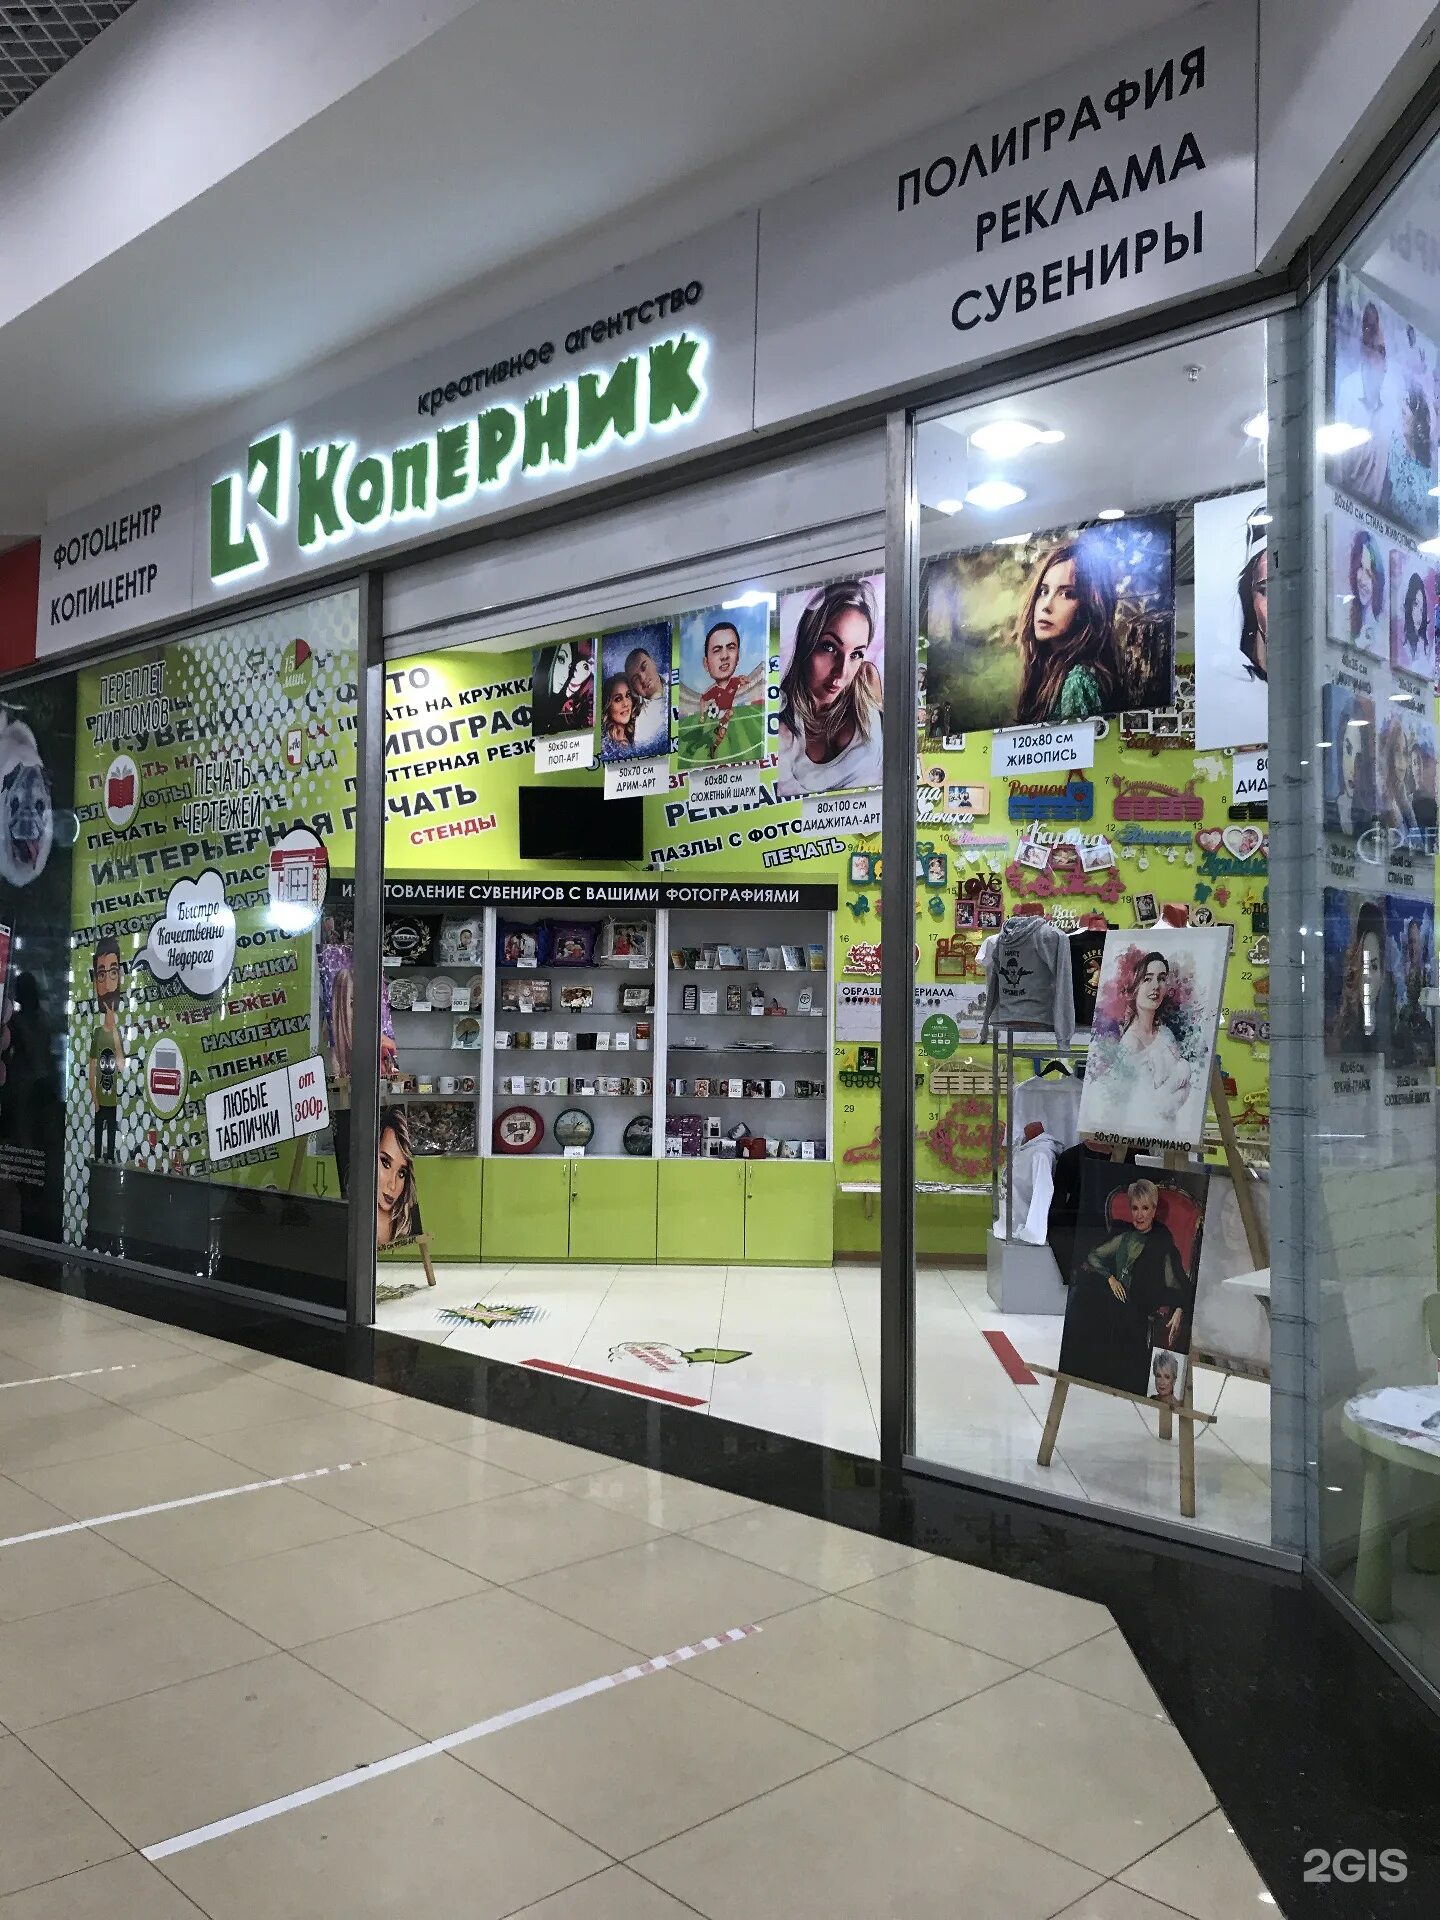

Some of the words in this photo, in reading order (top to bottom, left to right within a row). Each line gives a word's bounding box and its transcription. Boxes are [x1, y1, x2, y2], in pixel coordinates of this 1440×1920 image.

[897, 46, 1206, 212] ПОЛИГРАФИЯ
[976, 132, 1206, 252] РЕКЛАМА
[951, 210, 1204, 331] СУВЕНИРЫ
[417, 338, 555, 416] креативное
[564, 280, 704, 356] агентство
[53, 503, 162, 569] ФОТОЦЕНТР
[50, 563, 158, 626] КОПИЦЕНТР
[100, 660, 166, 707] ПЕРЕПЛЕТ
[425, 696, 453, 713] НА
[94, 696, 170, 748] ДИПЛОМОВ
[487, 738, 535, 762] РЕЗК
[569, 740, 580, 749] см
[1013, 733, 1052, 749] 120х80
[1056, 733, 1073, 744] см
[548, 753, 580, 766] ПОП-АРТ
[1006, 748, 1077, 767] ЖИВОПИСЬ
[194, 758, 251, 797] ПЕЧАТЬ
[619, 765, 641, 778] 50х70
[642, 767, 654, 776] см
[704, 773, 729, 787] 60х80
[730, 774, 743, 784] см
[616, 778, 656, 793] ДРИМ-АРТ
[690, 786, 732, 803] СЮЖЕТНЫЙ
[733, 786, 757, 799] ШАРЖ
[1236, 777, 1268, 795] ДИД
[182, 791, 262, 835] ЧЕРТЕЖЕЙ
[817, 800, 851, 814] 80х100
[853, 801, 867, 810] см
[410, 814, 497, 845] СТЕНДЫ
[803, 812, 881, 832] ДИДЖИТАЛ-АРТ
[1105, 823, 1116, 832] 12
[1193, 822, 1203, 830] 13
[87, 821, 167, 849] ПЕЧАТЬ
[939, 833, 949, 842] 10
[651, 836, 723, 864] ПАЗЛЫ
[728, 832, 743, 848] С
[763, 836, 846, 868] ПЕЧАТЬ
[469, 884, 565, 900] СУВЕНИРОВ
[568, 885, 581, 900] С
[586, 886, 659, 902] ВАШИМИ
[666, 887, 800, 903] ФОТОГРАФИЯМИ
[177, 901, 220, 922] Быстро
[157, 923, 225, 945] Качественно
[839, 934, 850, 943] 16
[928, 933, 939, 942] 17
[1242, 935, 1253, 944] 21
[167, 948, 214, 970] Недорого
[1241, 971, 1253, 980] 22
[842, 987, 881, 996] ОБРАЗЦ
[914, 988, 955, 997] ЕРИАЛА
[201, 1014, 312, 1053] НАКЛЕЙКИ
[834, 1047, 846, 1056] 24
[207, 1049, 288, 1080] ПЛЕНКЕ
[223, 1082, 269, 1120] ЛЮБЫЕ
[298, 1070, 316, 1089] от
[844, 1104, 855, 1113] 29
[928, 1112, 939, 1121] 31
[216, 1110, 281, 1152] ТАБЛИЧКИ
[1121, 1136, 1135, 1146] см
[1137, 1136, 1192, 1152] МУРЧИАНО
